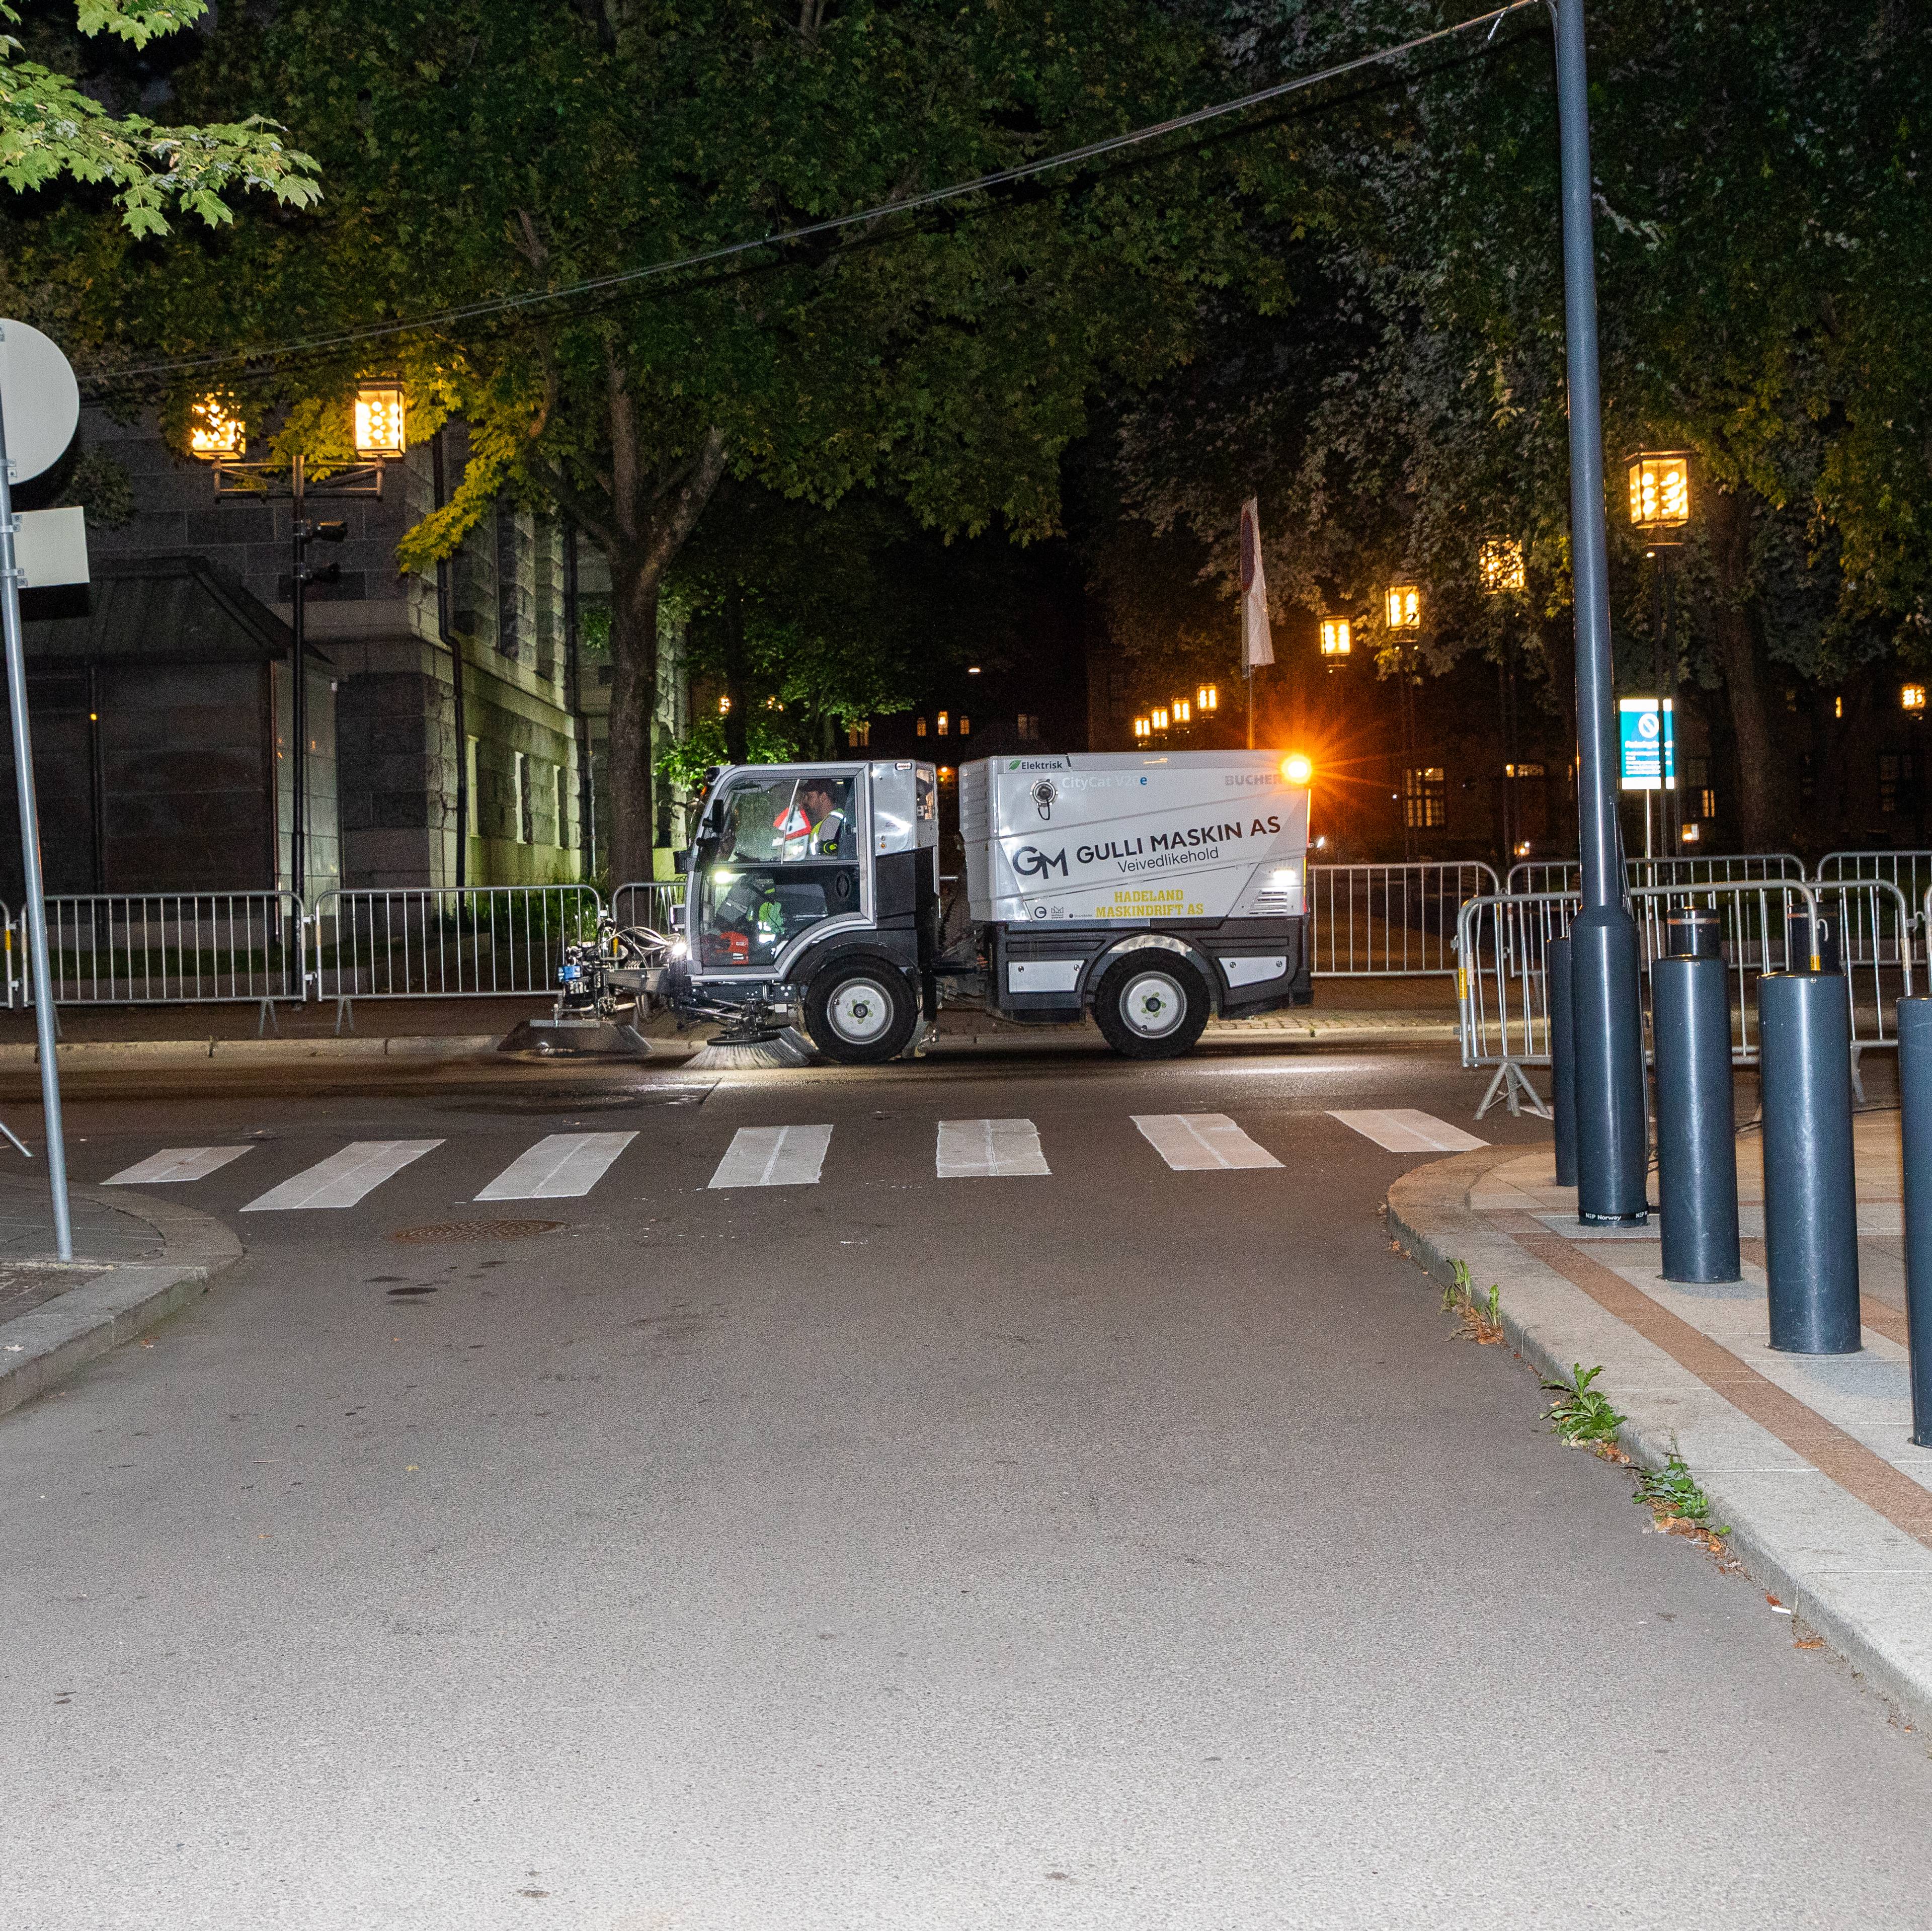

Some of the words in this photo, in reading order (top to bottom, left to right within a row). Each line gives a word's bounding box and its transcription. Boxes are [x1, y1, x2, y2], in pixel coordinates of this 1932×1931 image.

[1022, 761, 1063, 769] Elektrisk
[1062, 776, 1111, 790] CityCat
[1225, 774, 1282, 785] BUCHER
[1076, 837, 1144, 864] GULLI
[1150, 822, 1242, 852] MASKIN
[1250, 816, 1281, 837] AS
[1117, 847, 1219, 873] Veivedlikehold
[1114, 889, 1184, 903] HADELAND
[1096, 904, 1184, 918] MASKINDRIFT
[1187, 903, 1204, 915] AS
